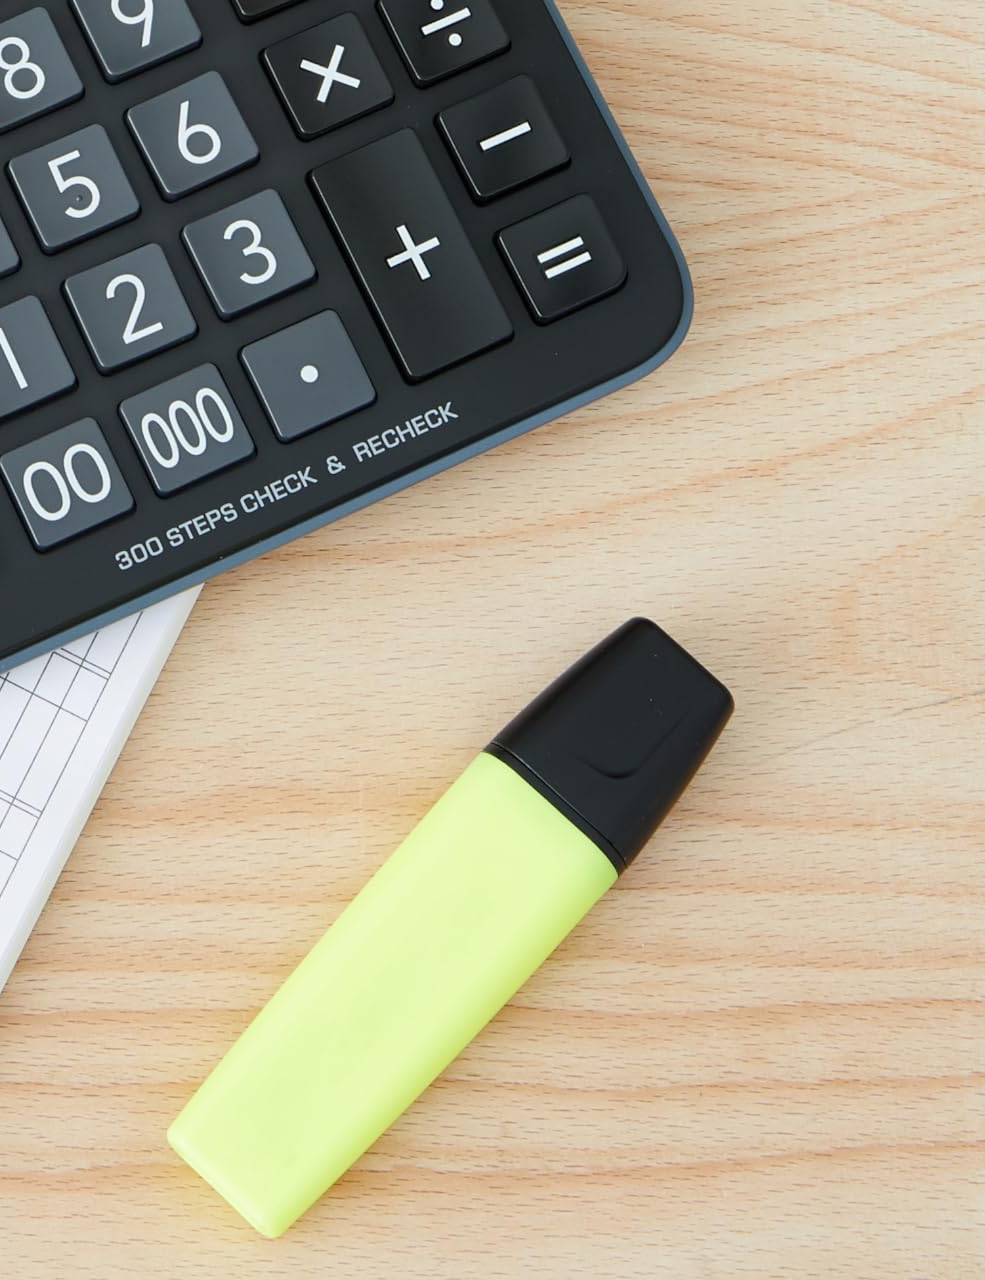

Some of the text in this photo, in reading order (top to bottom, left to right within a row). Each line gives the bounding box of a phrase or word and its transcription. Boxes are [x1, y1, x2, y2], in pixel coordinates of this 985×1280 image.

[176, 100, 222, 165] 6
[47, 150, 101, 218] 5
[223, 219, 277, 285] 3
[105, 273, 164, 345] 2
[140, 387, 235, 469] 000
[22, 442, 112, 522] 00
[114, 401, 459, 572] 300 STEPS CHECK & RECHECK
